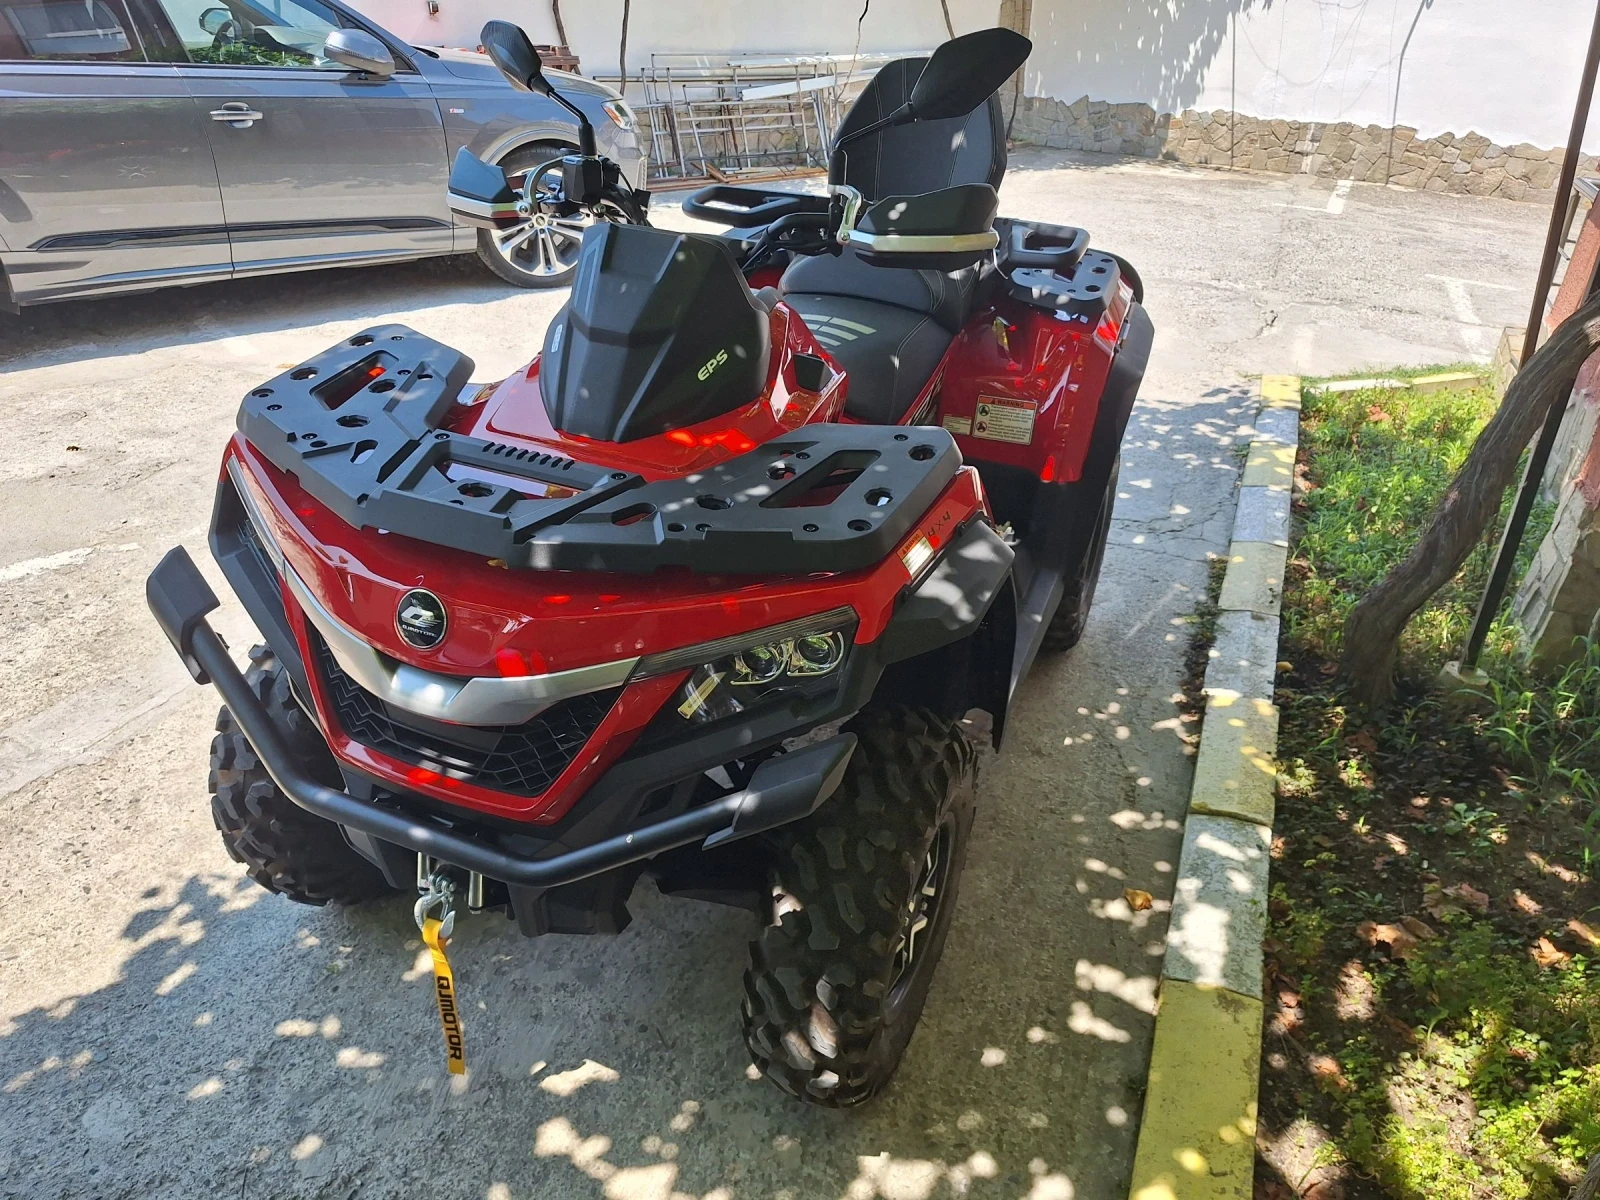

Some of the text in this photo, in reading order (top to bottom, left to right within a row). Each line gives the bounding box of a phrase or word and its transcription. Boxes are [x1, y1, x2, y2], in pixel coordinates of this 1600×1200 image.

[698, 349, 728, 381] EPS
[997, 400, 1025, 408] WARNING
[437, 975, 463, 1060] QJMOTOR
